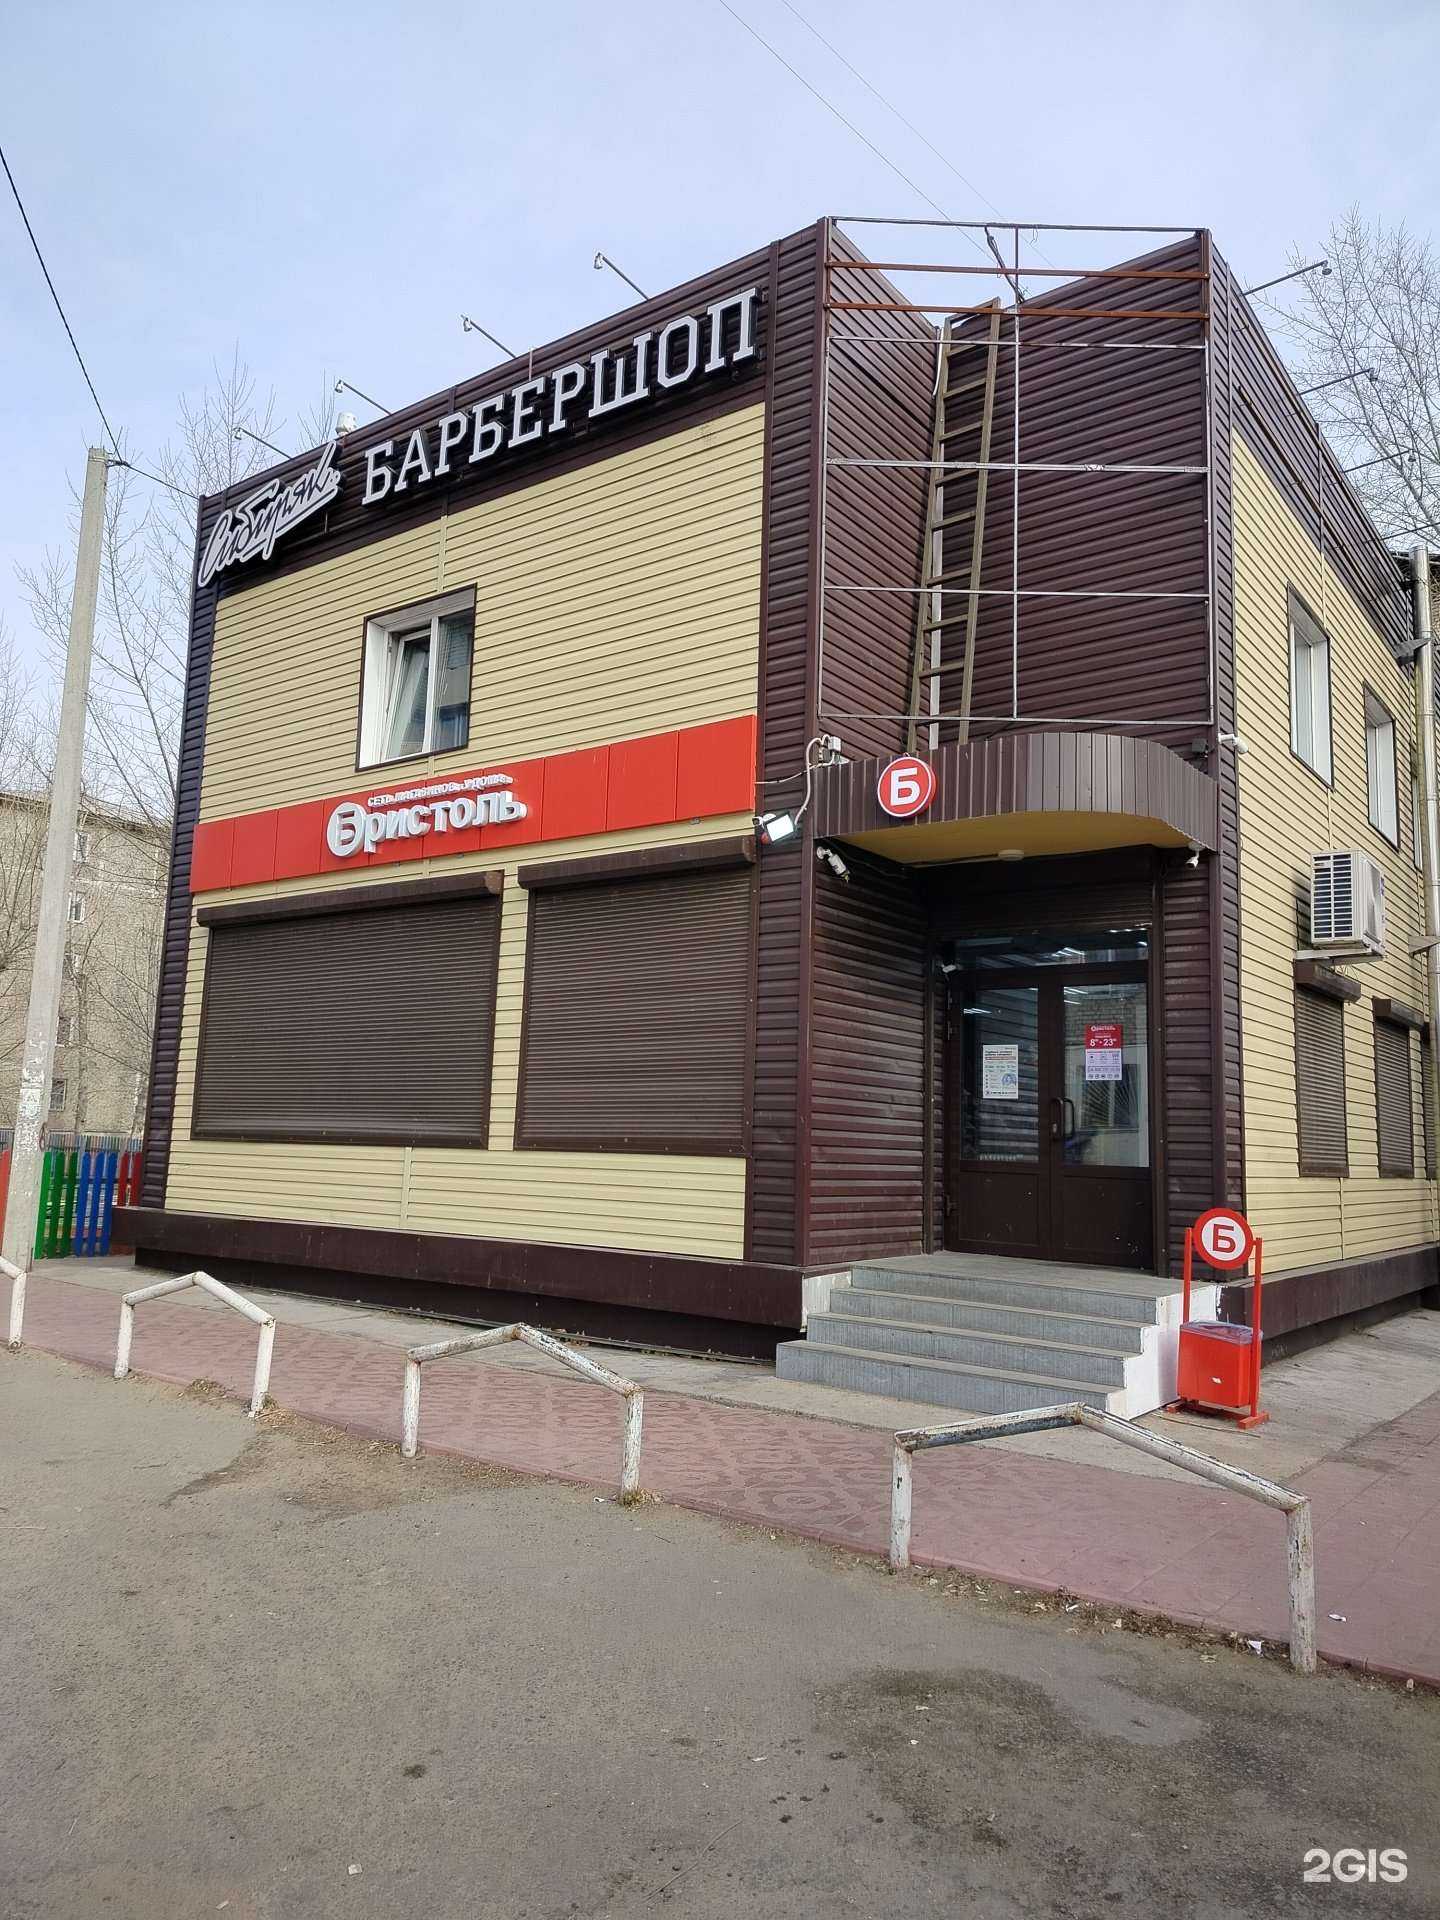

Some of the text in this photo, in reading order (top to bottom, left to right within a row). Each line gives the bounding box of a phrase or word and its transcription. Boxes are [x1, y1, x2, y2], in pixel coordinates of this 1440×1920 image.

[362, 287, 758, 506] БАРБЕРШОП
[368, 794, 395, 807] СЕТЬ
[890, 767, 920, 806] Б
[1212, 1223, 1236, 1253] Б
